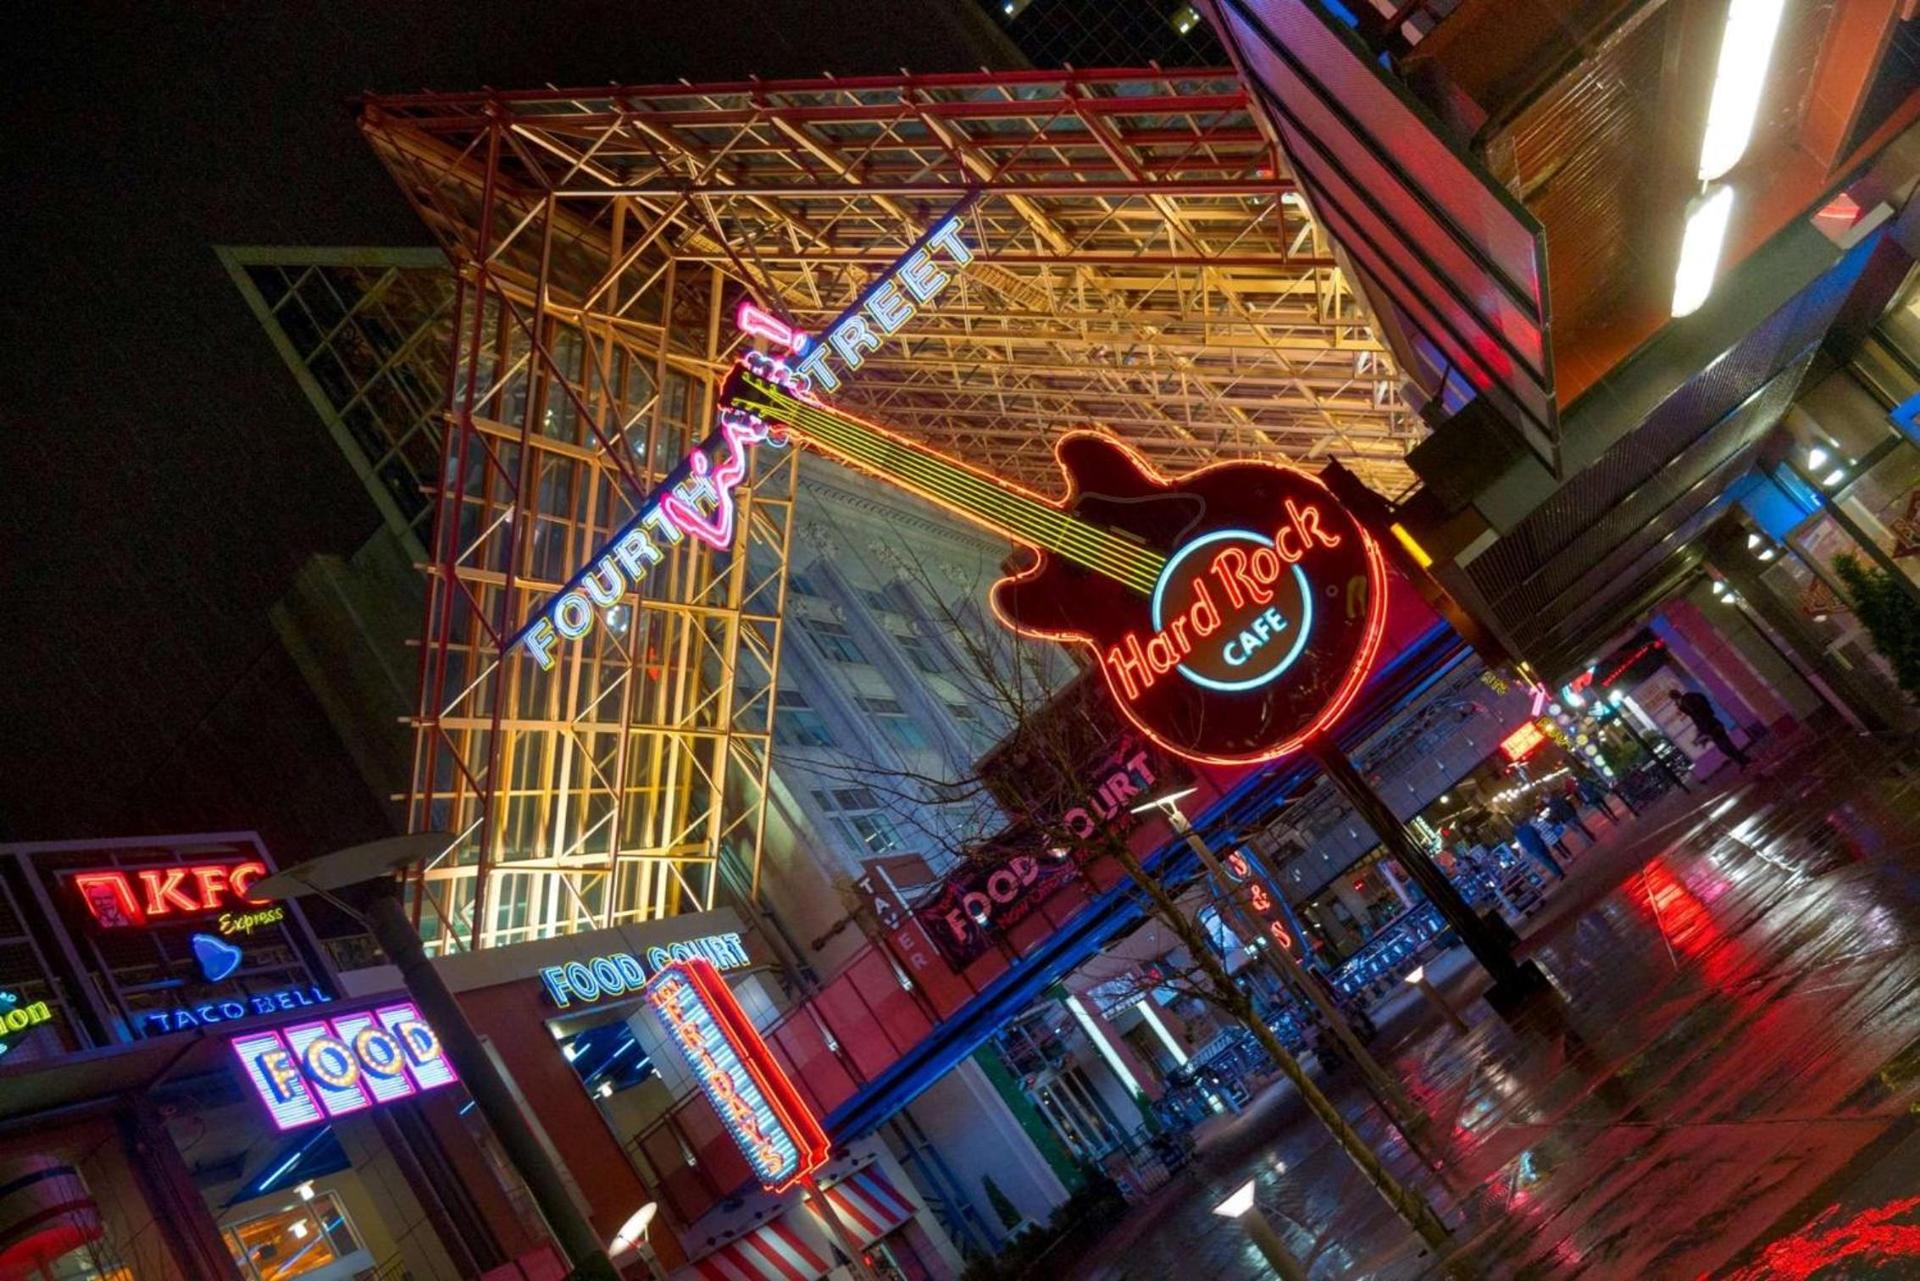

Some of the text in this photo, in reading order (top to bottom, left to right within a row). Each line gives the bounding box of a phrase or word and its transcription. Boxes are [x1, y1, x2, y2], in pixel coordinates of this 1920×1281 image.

[522, 215, 976, 671] FOURTH TREET
[1108, 499, 1341, 701] Hard Rock
[1222, 607, 1287, 667] CAFE
[945, 855, 1039, 942] FOOD
[1042, 751, 1156, 858] OURT
[139, 862, 274, 915] KFC
[219, 907, 284, 935] Express
[151, 986, 332, 1033] TACO BELL
[540, 953, 646, 1008] FOOD
[255, 1018, 443, 1104] FOOD
[664, 998, 784, 1174] FRIDAY'S
